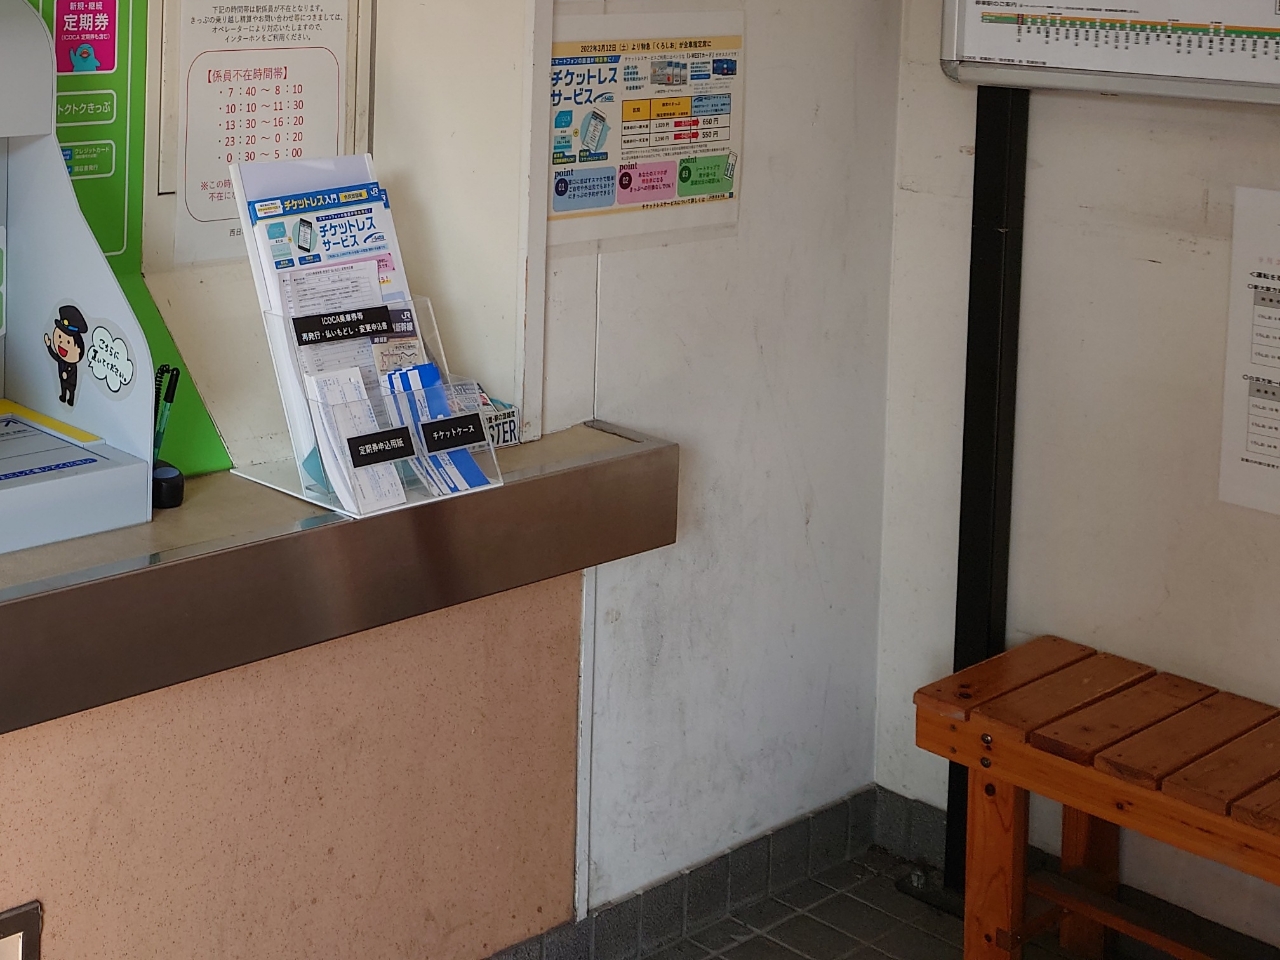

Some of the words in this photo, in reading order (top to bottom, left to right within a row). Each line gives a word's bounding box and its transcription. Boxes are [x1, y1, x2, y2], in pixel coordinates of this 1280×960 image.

[63, 13, 109, 31] 定期券
[208, 67, 288, 83] 【係員不在時間帯】
[551, 67, 617, 87] チケットレス
[551, 89, 593, 106] サービス
[58, 101, 110, 115] トクトクきっぷ
[555, 168, 574, 178] point
[619, 162, 638, 172] point
[319, 216, 376, 238] チケットレス
[322, 234, 359, 251] サービス
[433, 425, 474, 440] チケットケース
[358, 438, 404, 455] 定期券申込用紙
